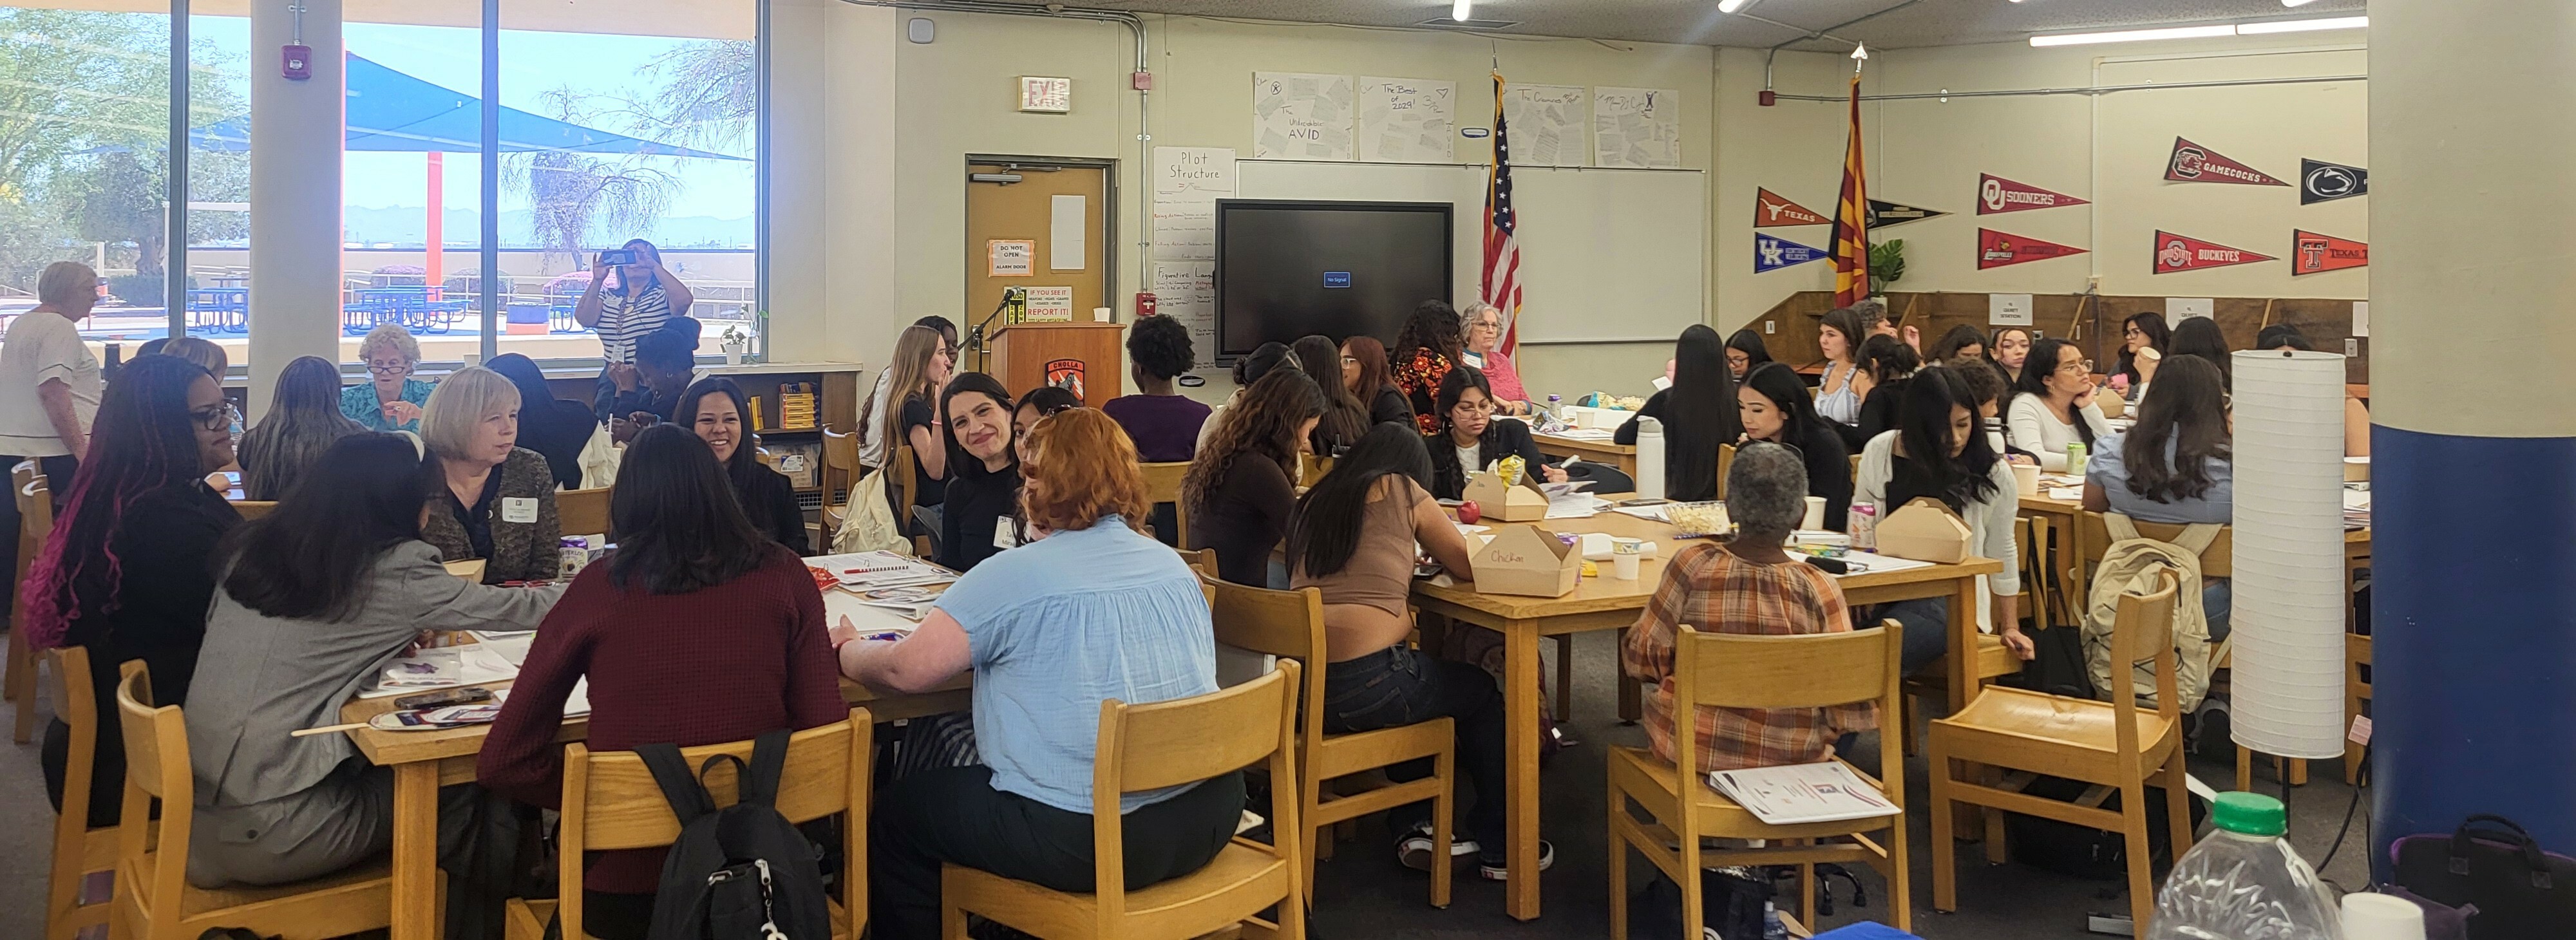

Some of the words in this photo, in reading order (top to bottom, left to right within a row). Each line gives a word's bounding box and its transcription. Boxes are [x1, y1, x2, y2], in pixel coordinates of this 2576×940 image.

[1381, 83, 1395, 94] The
[1396, 86, 1417, 95] Best
[1280, 105, 1293, 115] The
[1392, 99, 1416, 109] 2029!
[1288, 128, 1320, 140] AVID
[1181, 151, 1208, 164] Plot
[1170, 165, 1220, 178] Structure
[2203, 163, 2260, 182] GAMECOCKS
[1982, 180, 2006, 210] OU
[2006, 191, 2054, 205] SOONERS
[1784, 211, 1815, 223] TEXAS
[1758, 240, 1784, 265] UK
[2198, 249, 2240, 262] BUCKEYES
[2329, 249, 2360, 258] TEXAS
[1158, 267, 1189, 279] Figurative
[1195, 267, 1213, 279] Lang
